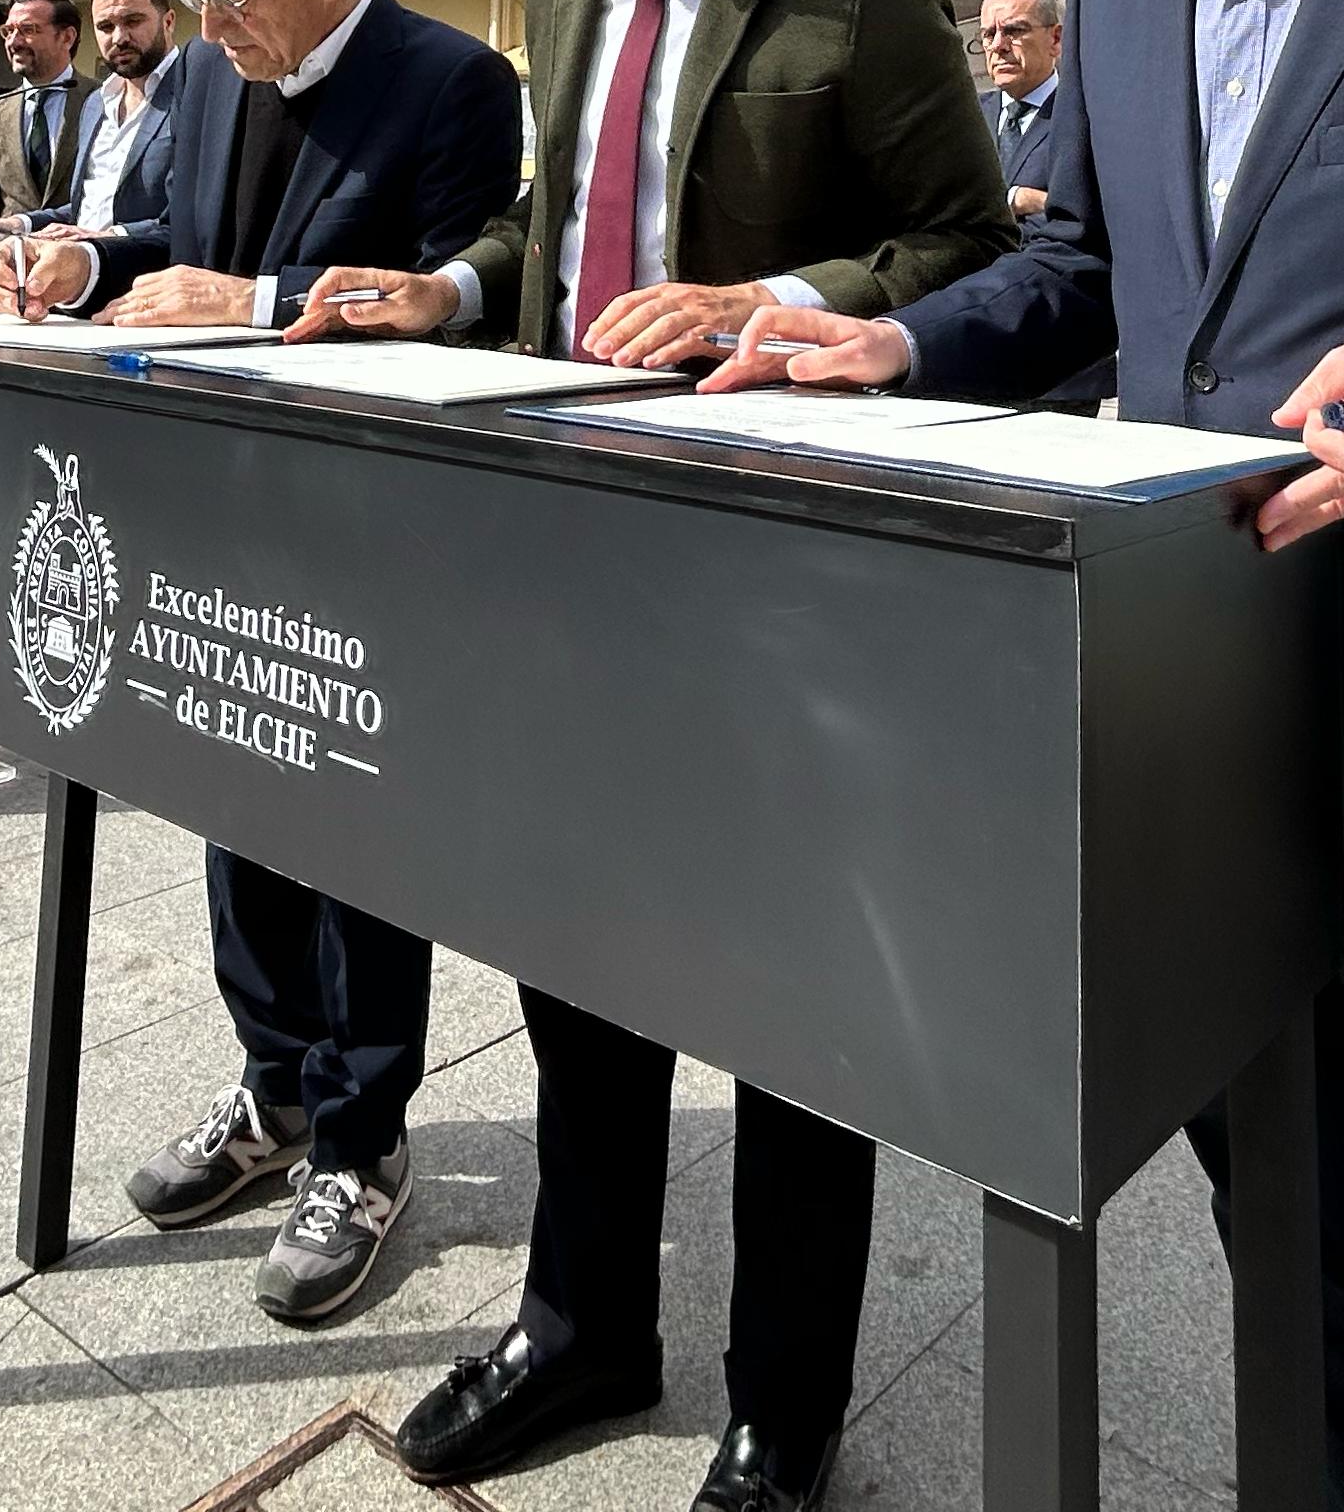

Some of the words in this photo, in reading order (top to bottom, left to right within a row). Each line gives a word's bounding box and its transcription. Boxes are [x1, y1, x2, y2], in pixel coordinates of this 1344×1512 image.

[73, 528, 98, 620] COLONIA
[147, 571, 366, 670] Excelentísimo
[128, 620, 383, 734] AYUNTAMIENTO
[176, 685, 210, 732] de
[218, 699, 317, 771] ELCHE
